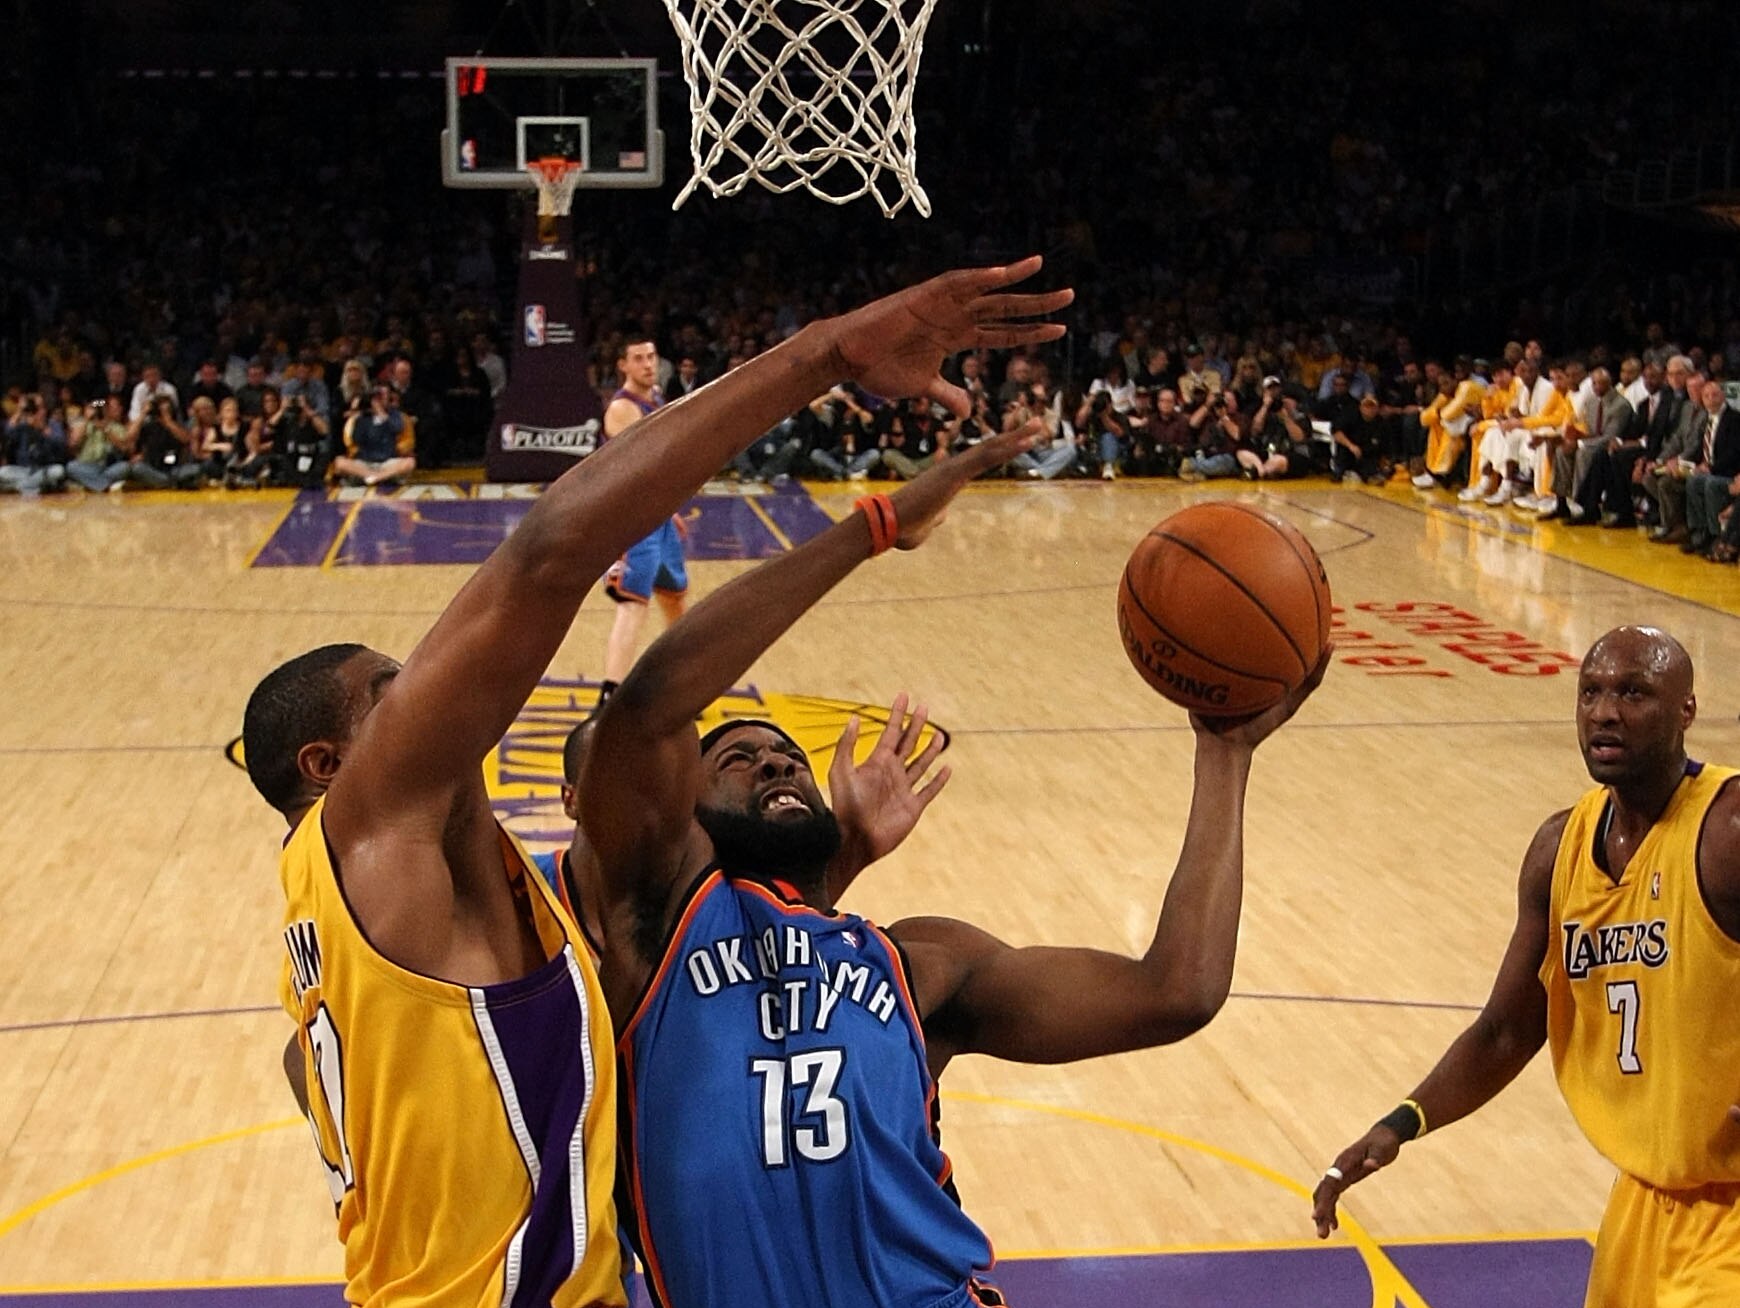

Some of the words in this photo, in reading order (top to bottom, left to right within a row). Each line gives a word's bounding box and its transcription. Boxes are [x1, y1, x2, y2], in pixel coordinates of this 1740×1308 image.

[1562, 921, 1669, 980] LAKERS
[1605, 980, 1644, 1075] 7
[750, 1047, 850, 1169] 13
